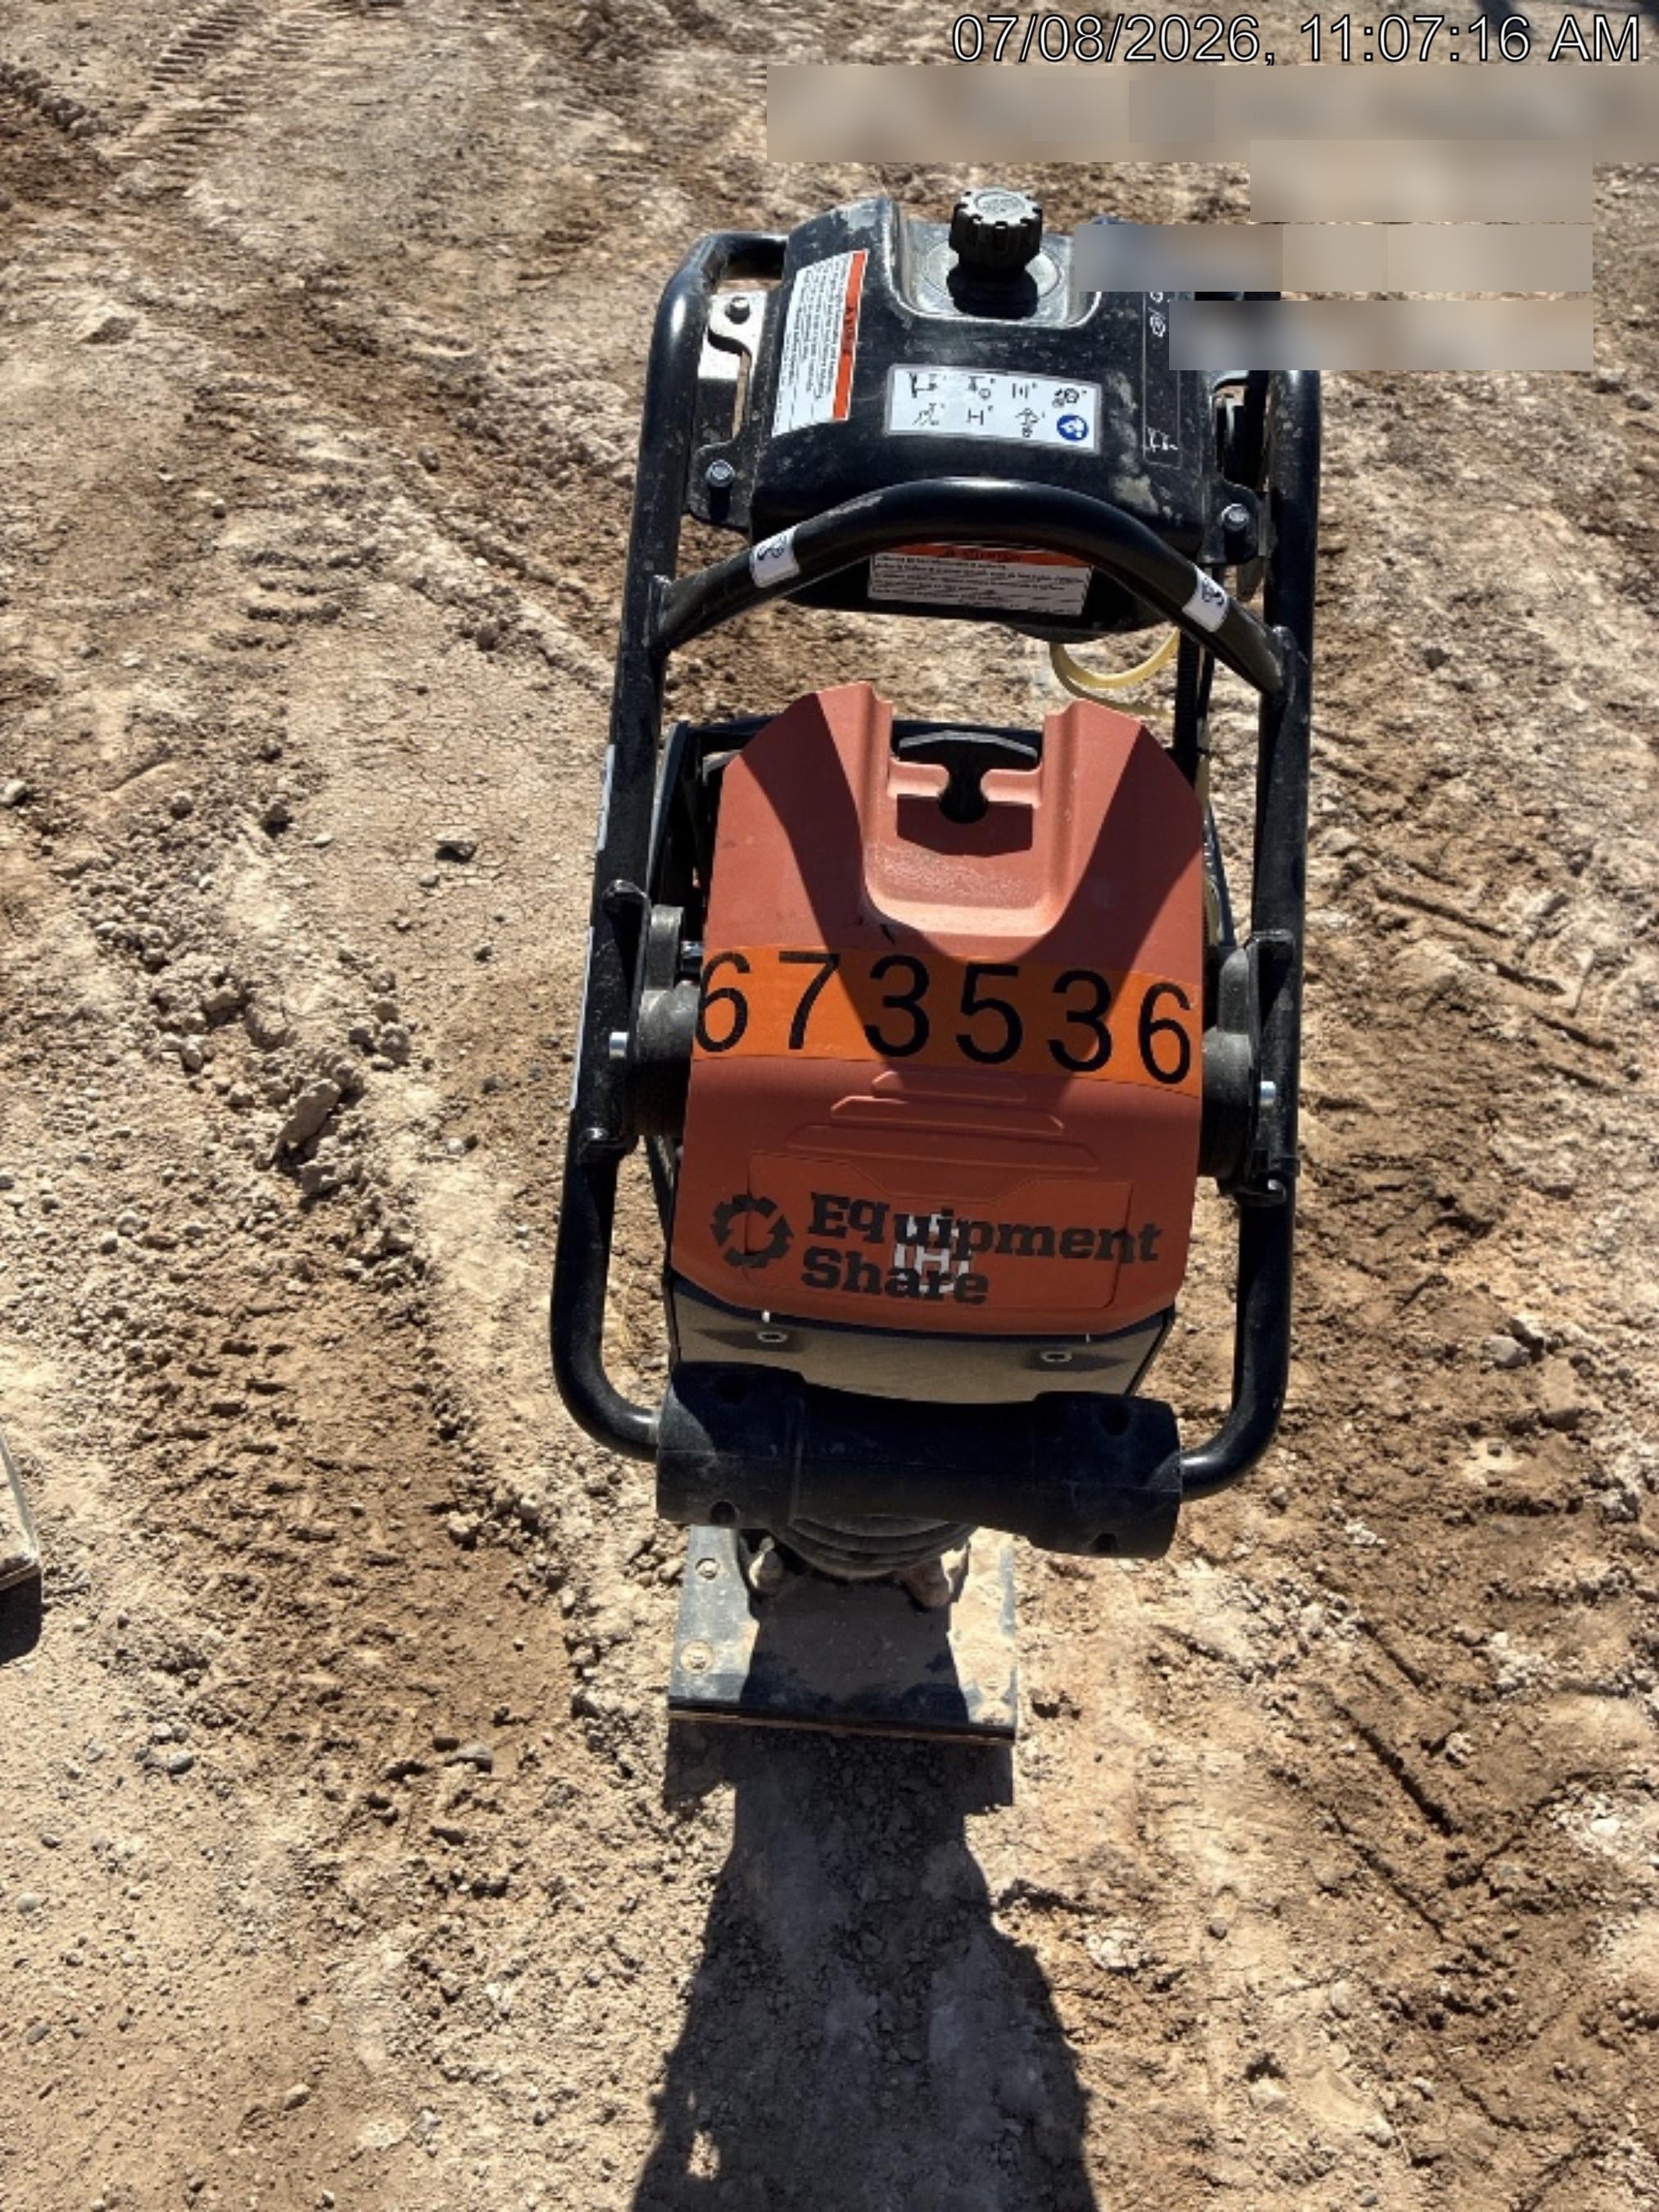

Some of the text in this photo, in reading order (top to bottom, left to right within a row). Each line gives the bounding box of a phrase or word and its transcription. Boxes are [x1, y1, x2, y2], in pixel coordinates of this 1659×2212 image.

[695, 950, 1191, 1084] 673536
[807, 1191, 1162, 1263] Equipment
[800, 1245, 990, 1303] Share
